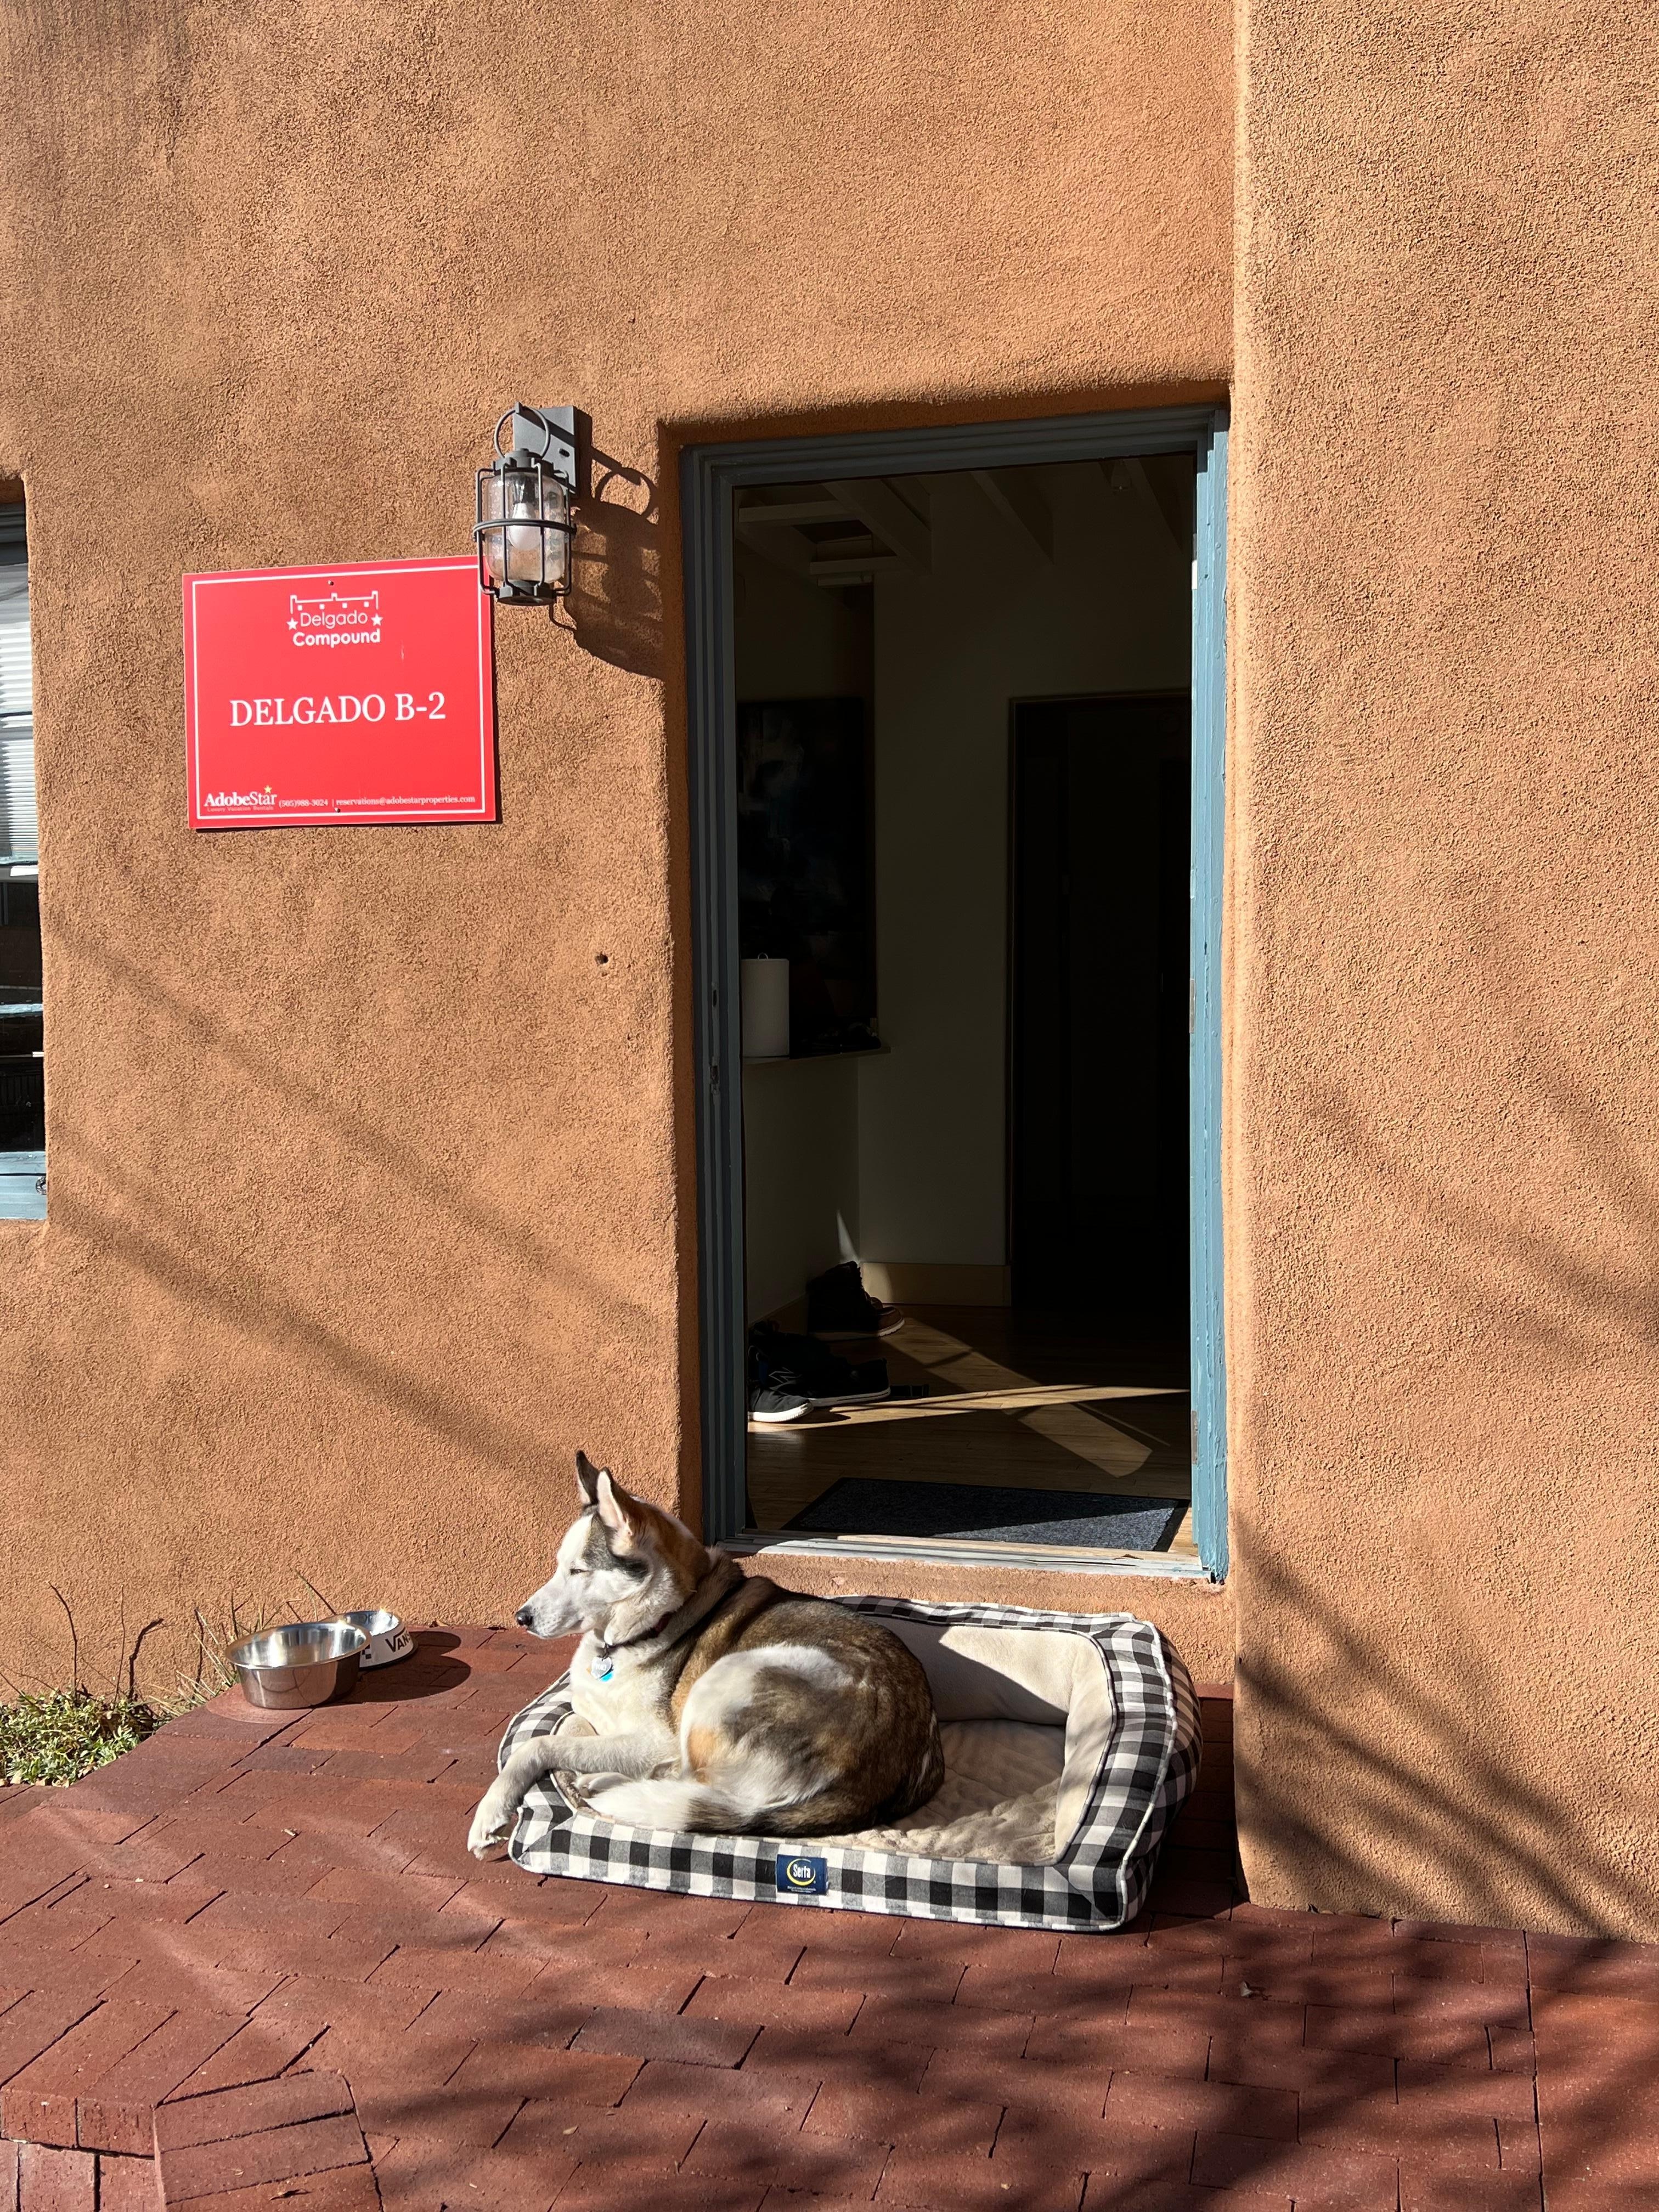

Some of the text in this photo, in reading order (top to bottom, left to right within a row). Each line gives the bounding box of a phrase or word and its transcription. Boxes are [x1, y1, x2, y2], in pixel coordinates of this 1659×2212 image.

[300, 610, 368, 629] Delgado
[292, 628, 380, 648] Compound
[229, 692, 446, 727] DELGADO B-2
[204, 792, 278, 806] AdobeStar
[336, 795, 476, 806] reservations@adobestarproperties.com
[793, 1864, 811, 1878] Serta
